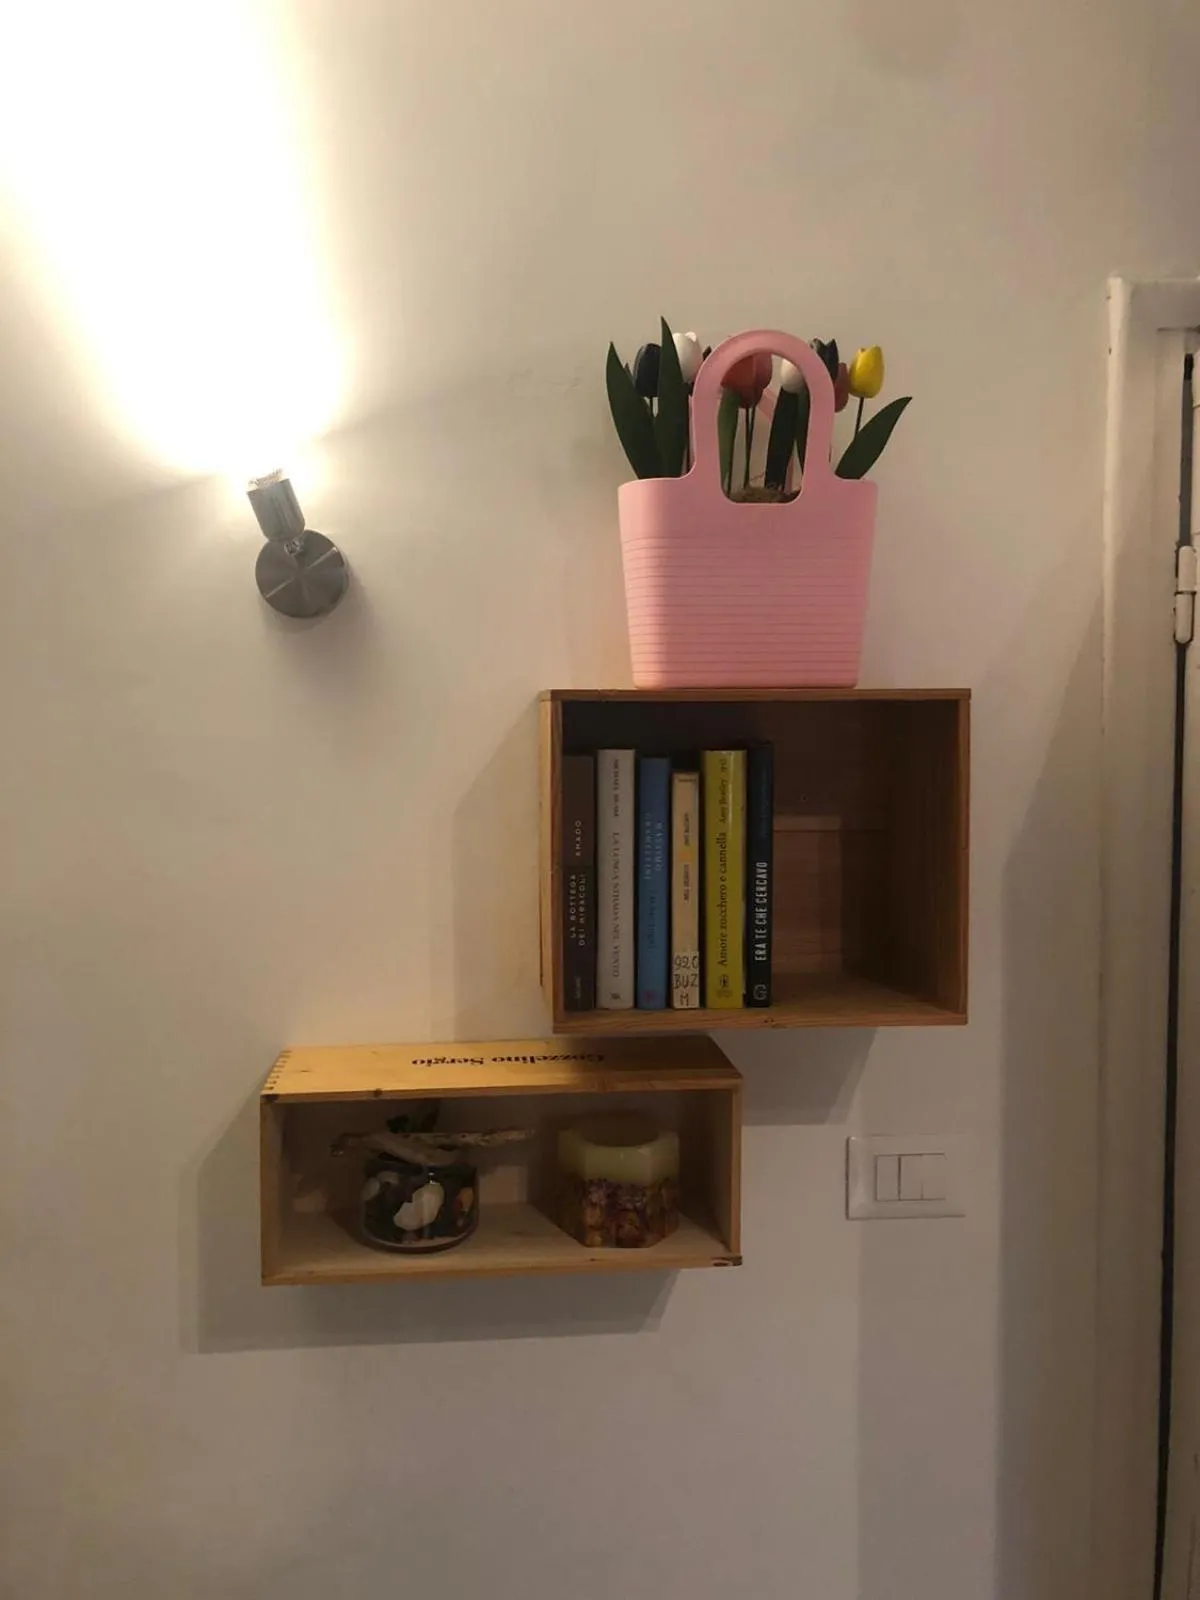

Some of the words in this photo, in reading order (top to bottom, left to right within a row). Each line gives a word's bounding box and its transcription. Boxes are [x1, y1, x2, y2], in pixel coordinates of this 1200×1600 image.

[716, 832, 728, 874] cannella
[755, 861, 768, 904] CERCAVO
[578, 873, 586, 924] MIRACOLI
[717, 885, 728, 930] zucchero
[755, 907, 768, 925] CHE
[569, 926, 576, 939] LA
[578, 928, 586, 947] DEI
[755, 928, 767, 939] TE
[717, 933, 728, 967] Amore
[755, 943, 767, 961] ERA
[612, 944, 620, 978] VENTO
[673, 973, 698, 989] BUZ
[411, 1056, 485, 1067] Sergio
